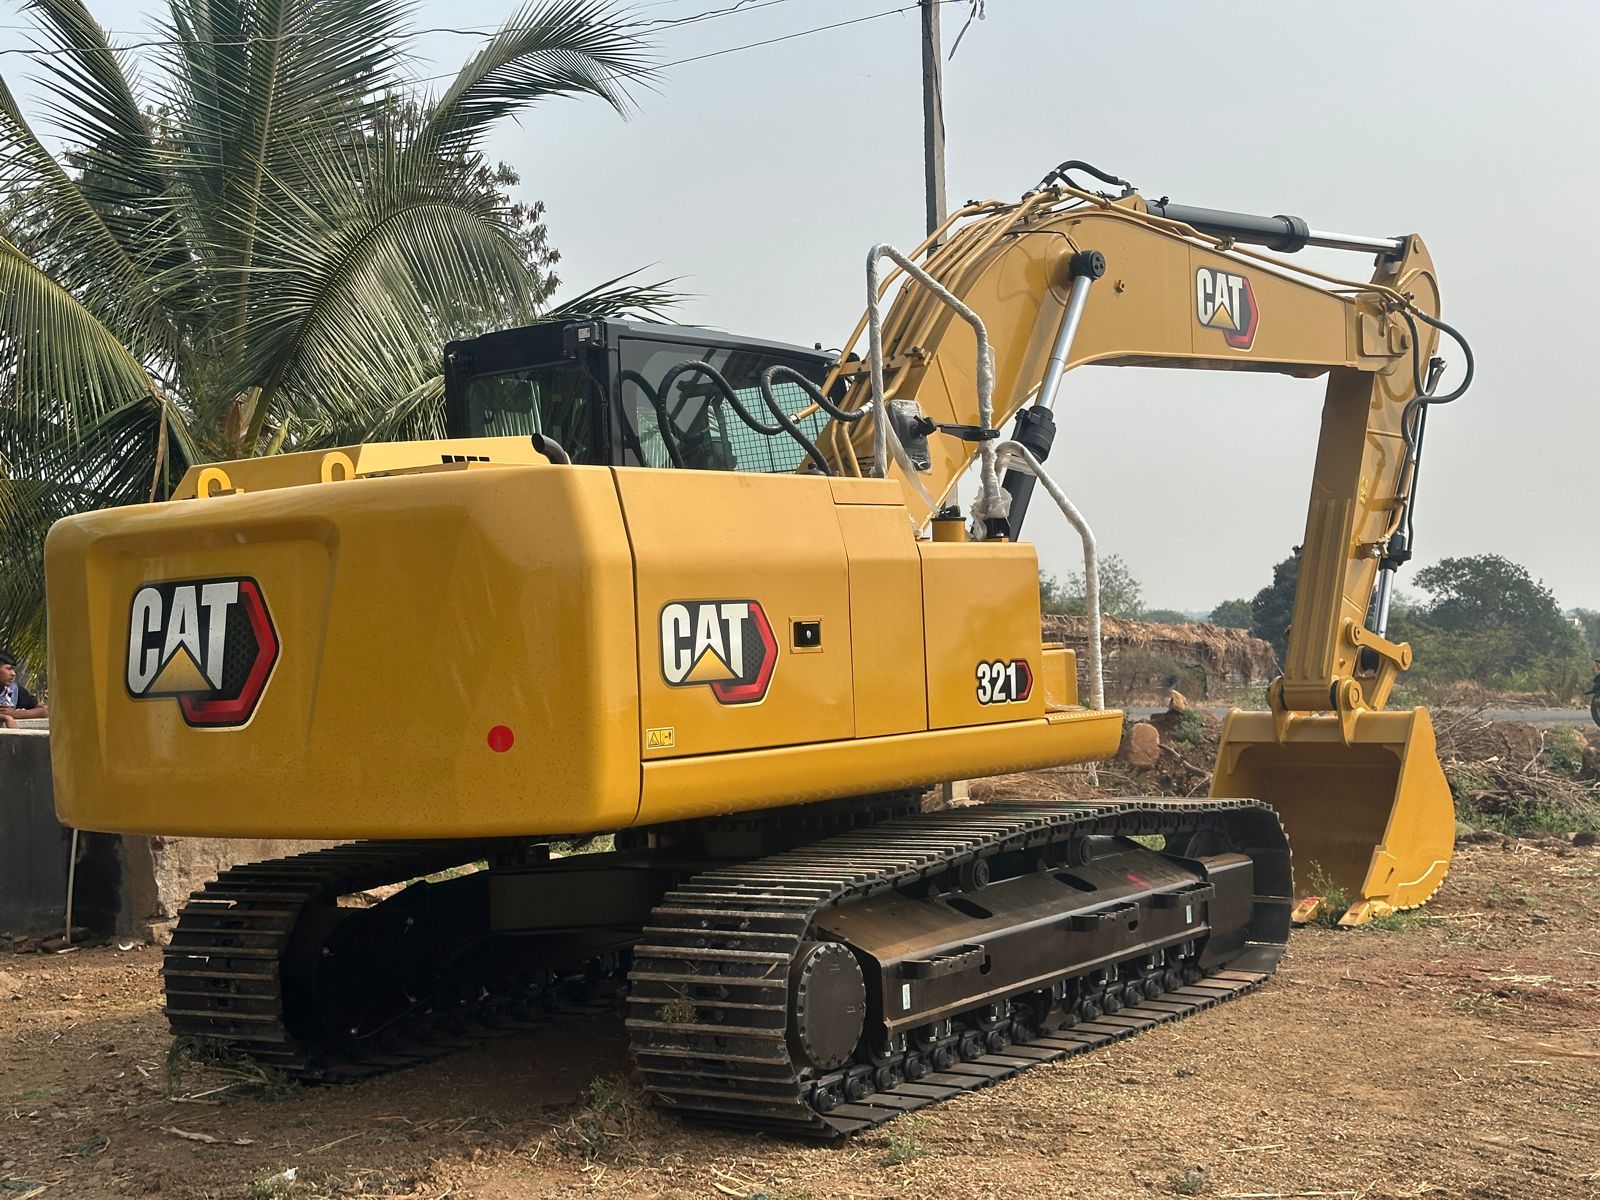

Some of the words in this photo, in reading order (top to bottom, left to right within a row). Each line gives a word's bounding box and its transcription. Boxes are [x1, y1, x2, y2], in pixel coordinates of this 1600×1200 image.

[1197, 268, 1242, 330] CAT
[128, 582, 239, 694] CAT
[662, 603, 748, 683] CAT
[977, 662, 1017, 702] 321
